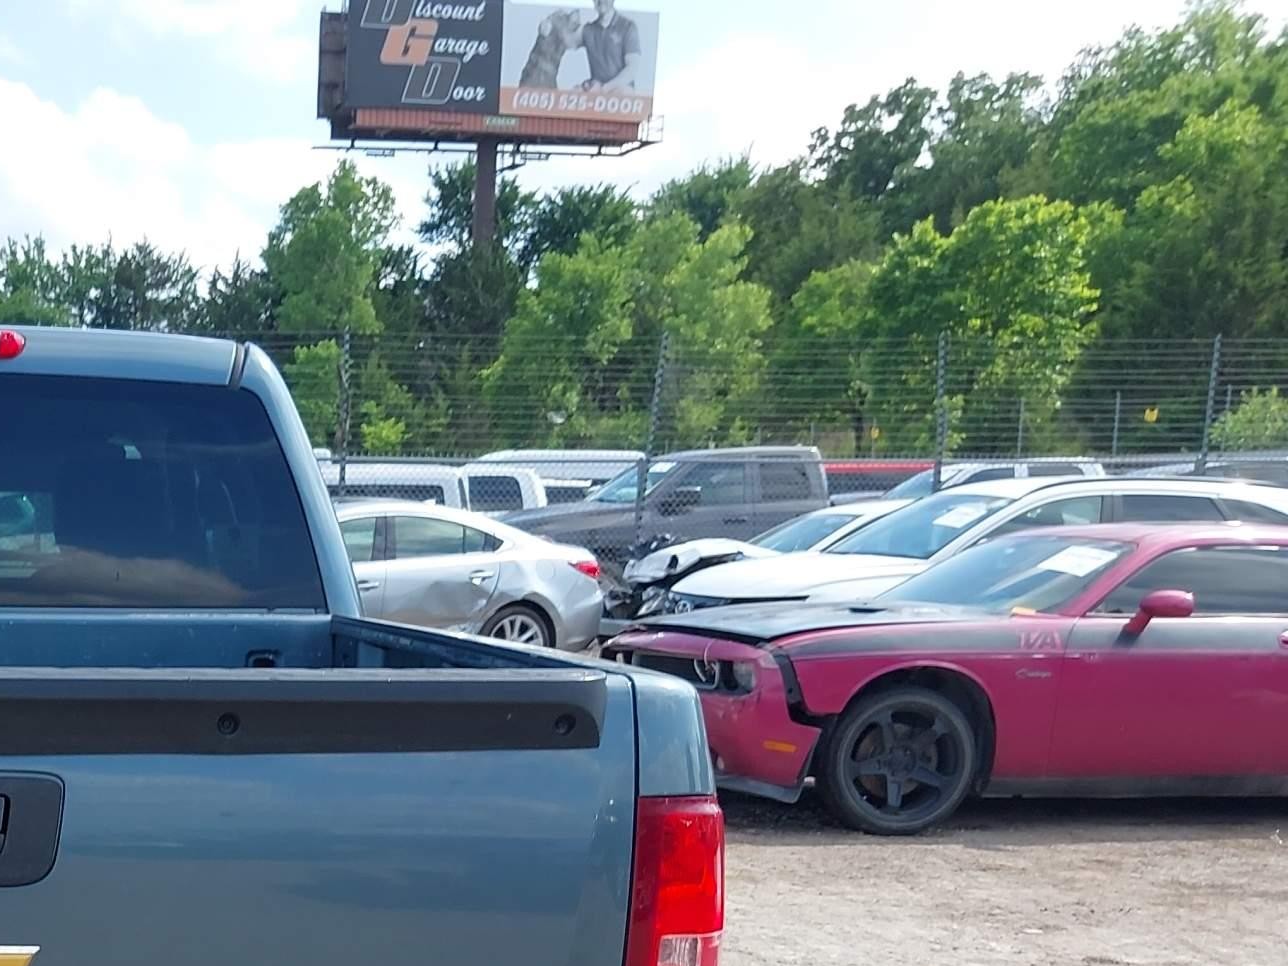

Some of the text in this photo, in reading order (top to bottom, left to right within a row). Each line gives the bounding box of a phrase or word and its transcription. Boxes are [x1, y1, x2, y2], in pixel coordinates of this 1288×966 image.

[380, 18, 490, 65] Garage
[401, 56, 486, 104] Door
[513, 91, 644, 113] (405) 525-DOOR
